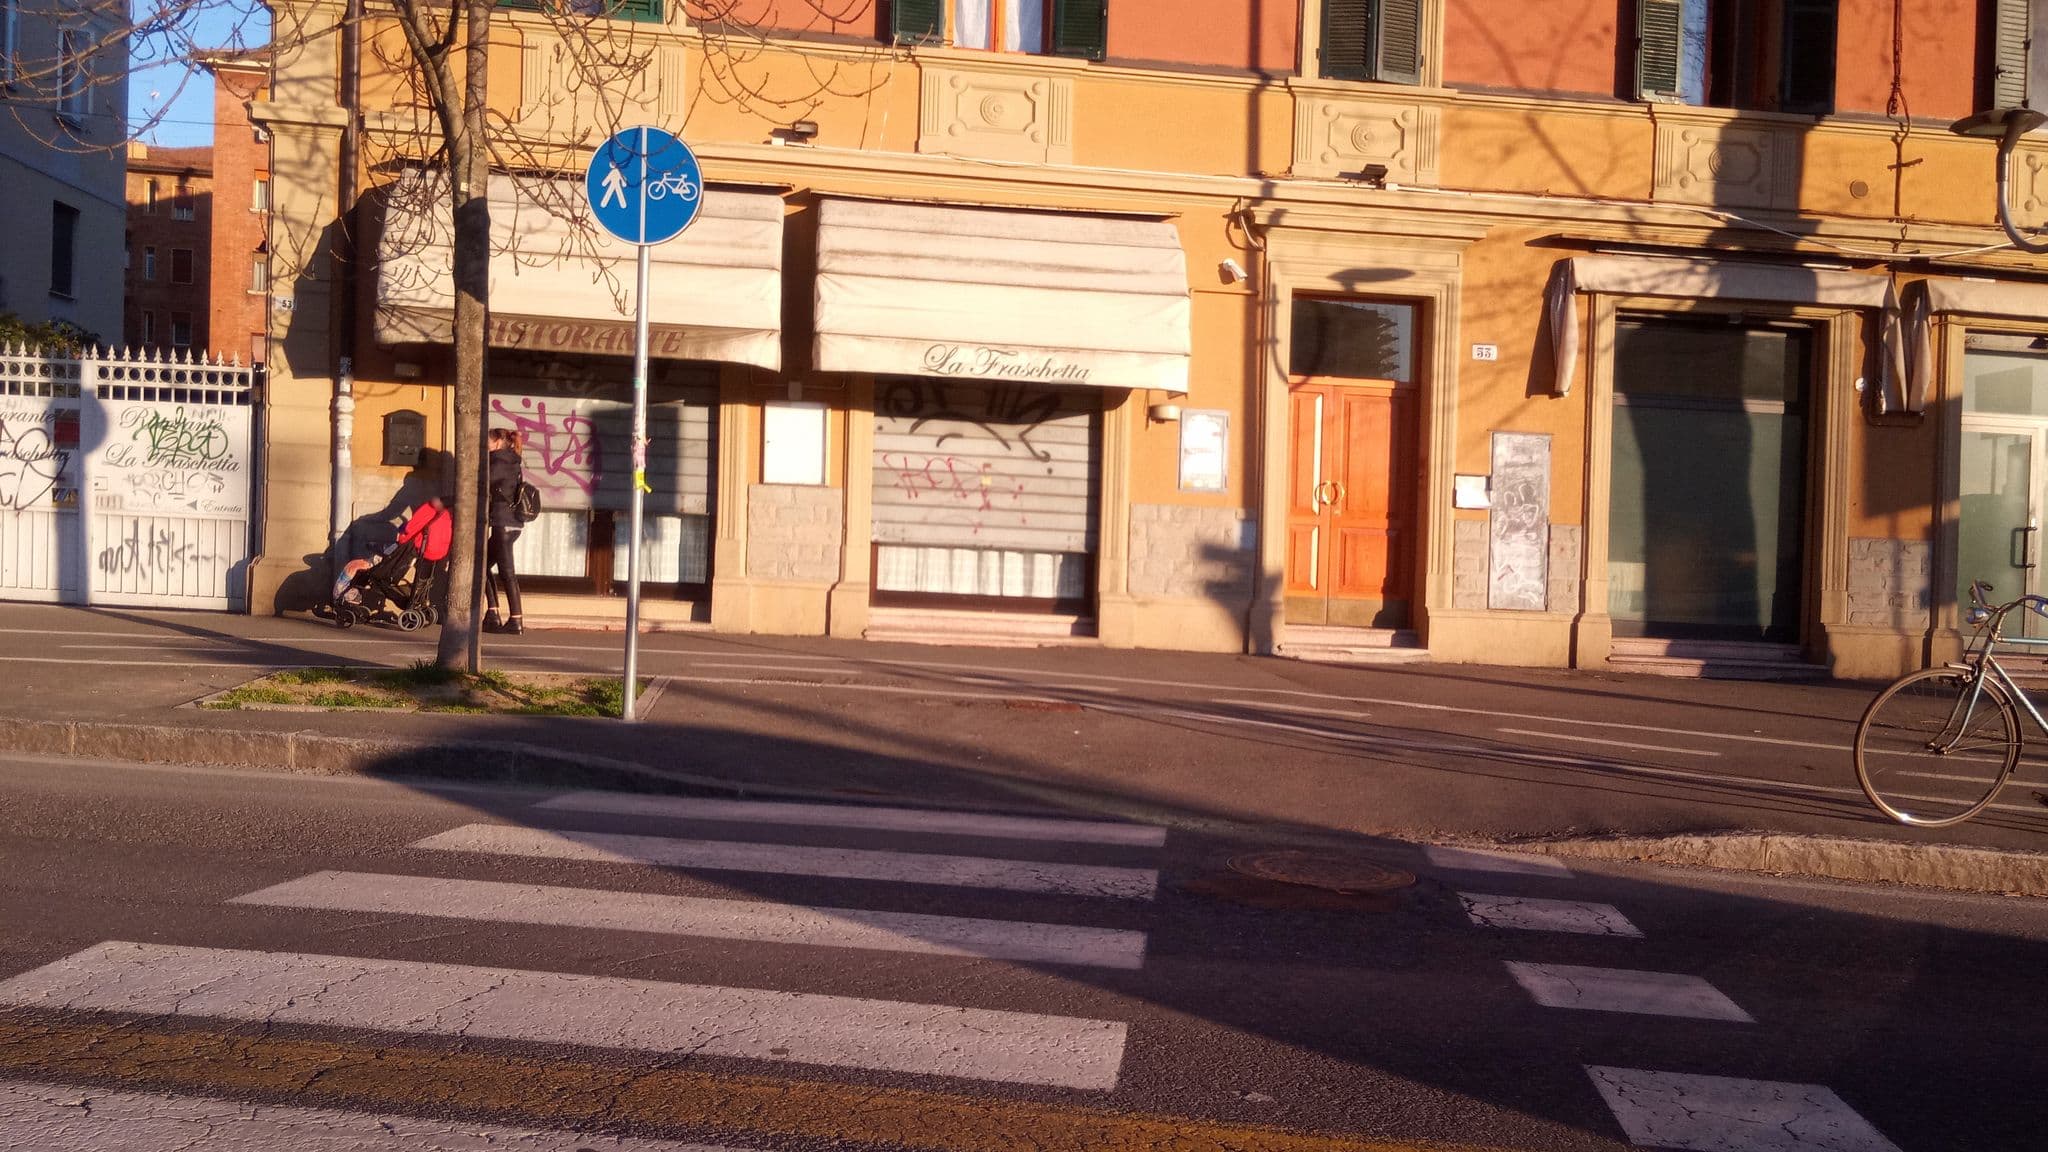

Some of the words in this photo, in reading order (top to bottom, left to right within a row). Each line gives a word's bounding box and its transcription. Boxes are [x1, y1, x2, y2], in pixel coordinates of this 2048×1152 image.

[489, 318, 686, 353] ISTORANTE
[919, 344, 965, 376] La
[970, 346, 1092, 381] Fraschetta
[102, 443, 137, 468] La
[142, 446, 241, 473] Fraschetta
